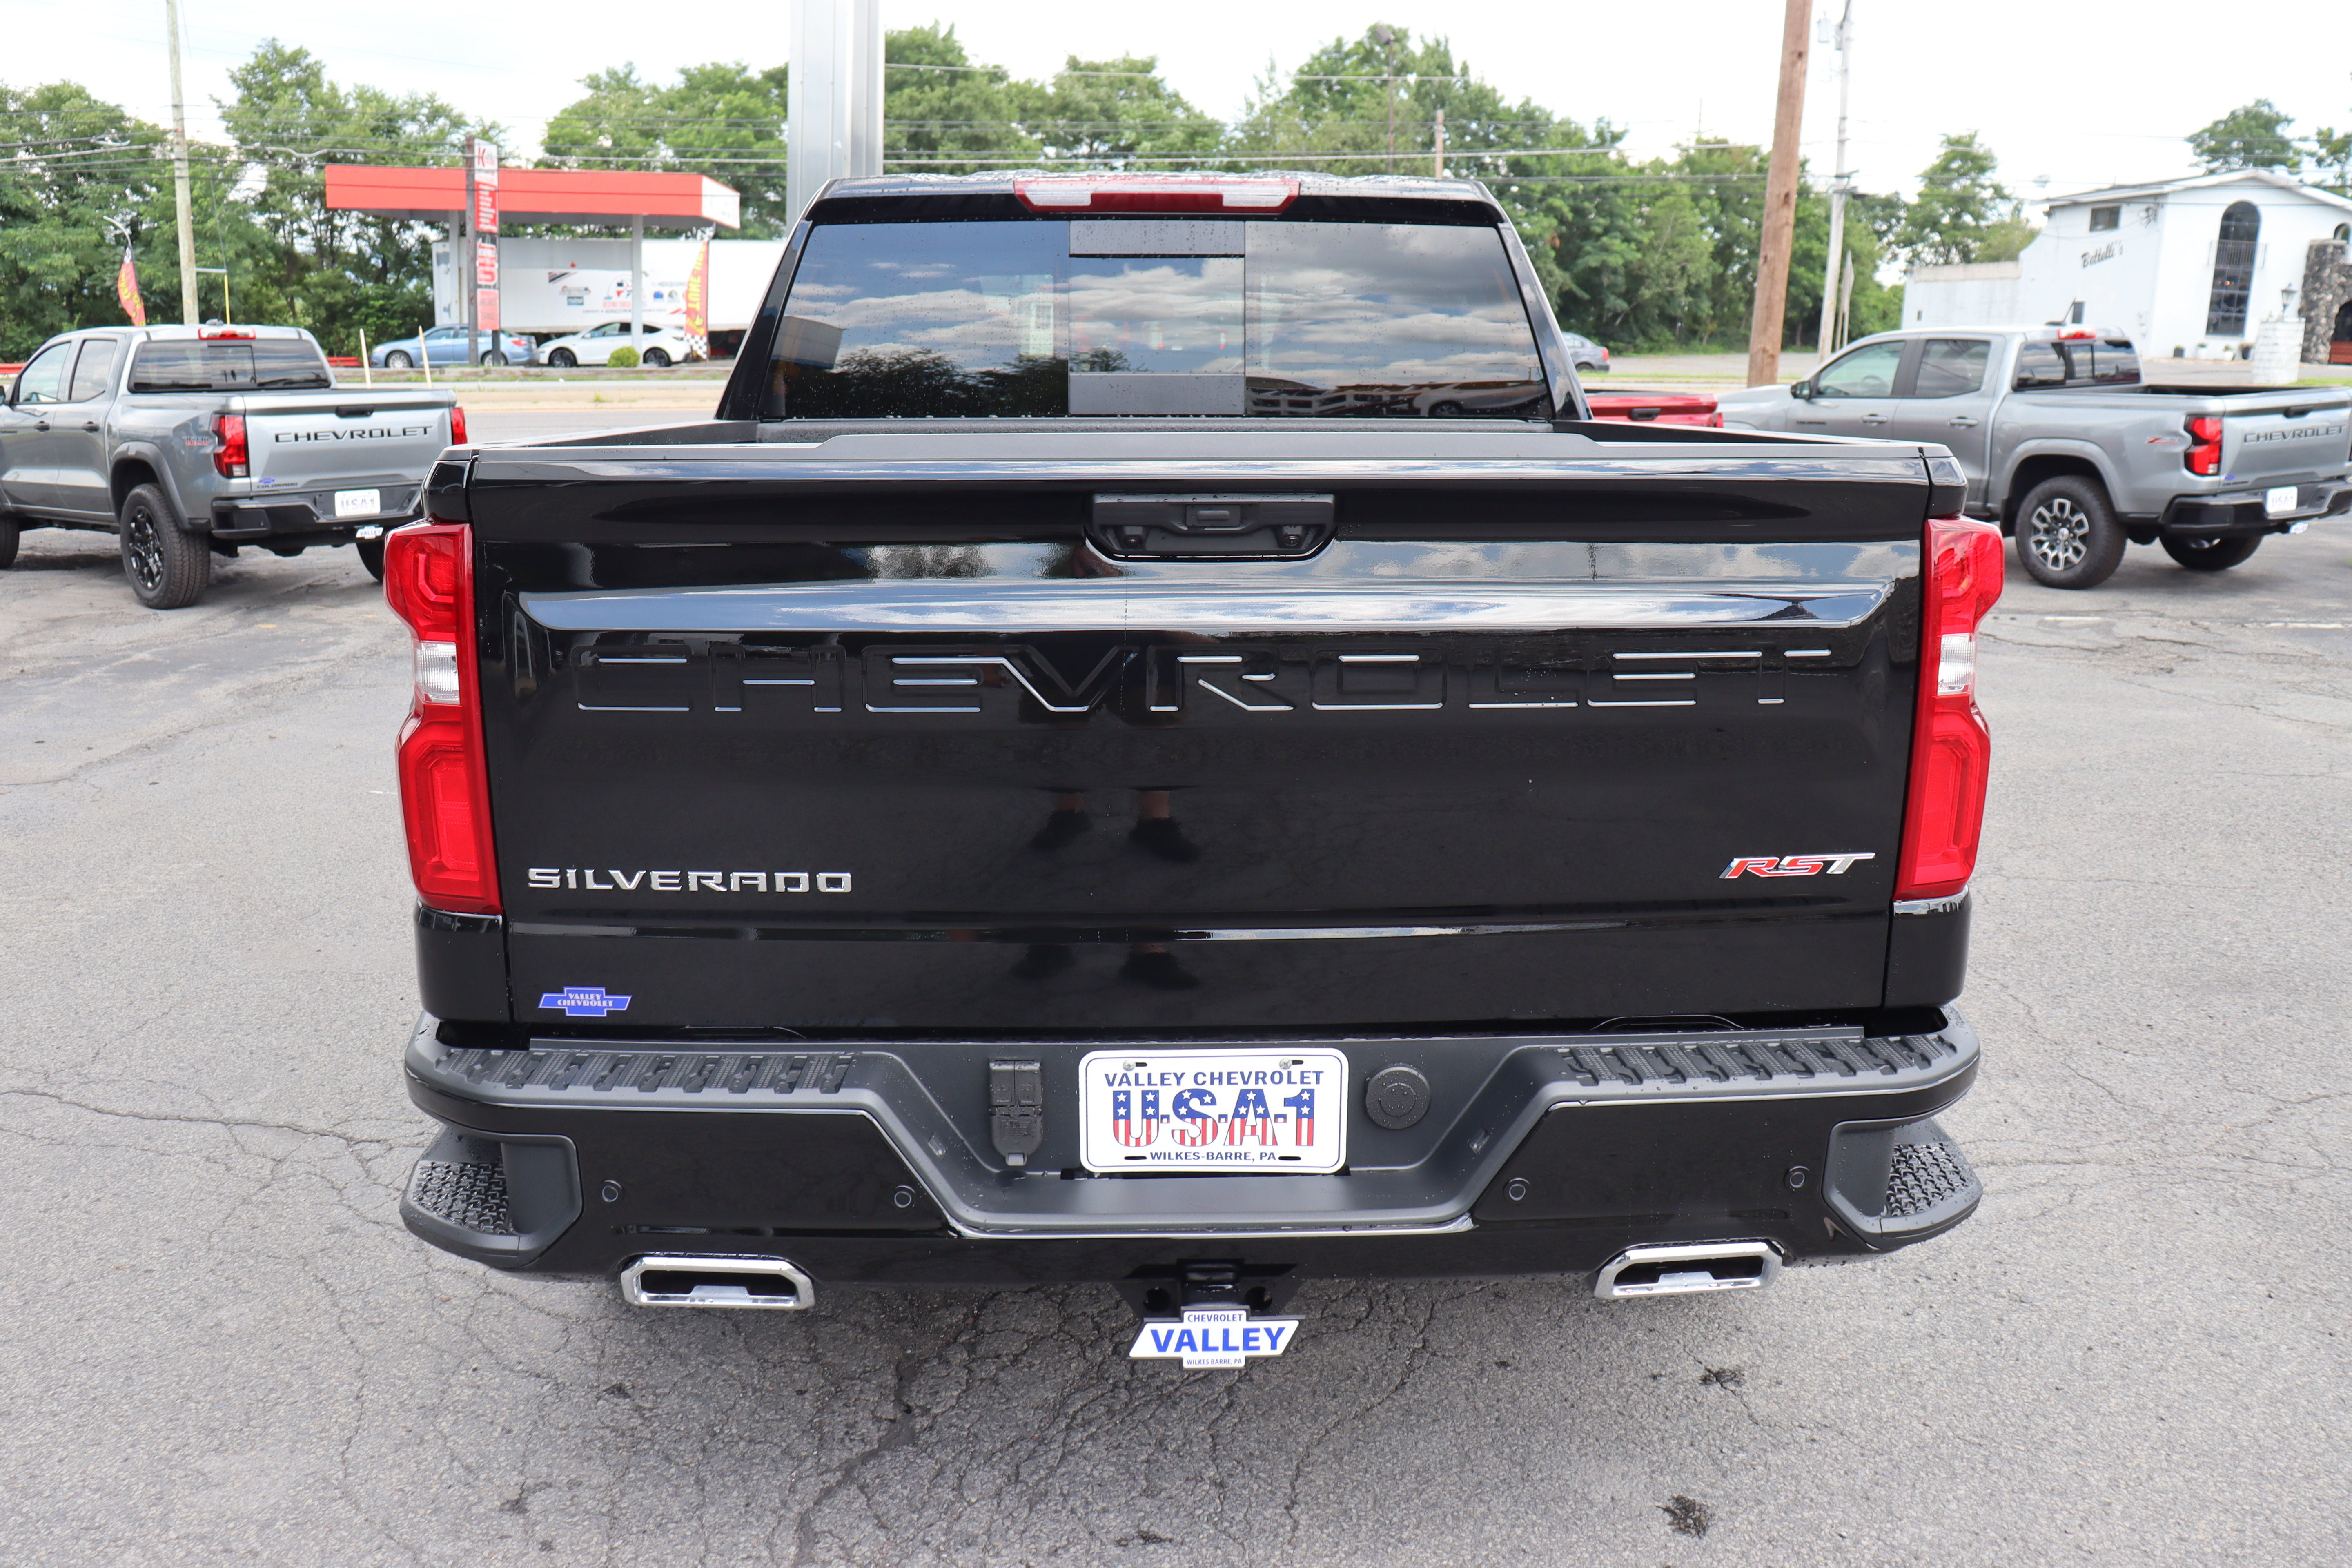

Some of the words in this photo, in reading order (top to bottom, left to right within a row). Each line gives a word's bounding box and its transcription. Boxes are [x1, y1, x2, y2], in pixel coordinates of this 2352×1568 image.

[274, 425, 433, 443] CHEVROLET
[2244, 425, 2345, 444] CHEVROLET
[573, 642, 1832, 713] CHEVROLET
[1719, 853, 1876, 879] RST
[528, 868, 852, 893] SILVERADO
[1104, 1071, 1185, 1087] VALLEY
[1193, 1070, 1324, 1085] CHEVROLET
[1150, 1152, 1255, 1162] WILKES-BARRE,
[1259, 1152, 1276, 1160] PA
[1187, 1314, 1243, 1322] CHEVROLET
[1150, 1327, 1286, 1353] VALLEY
